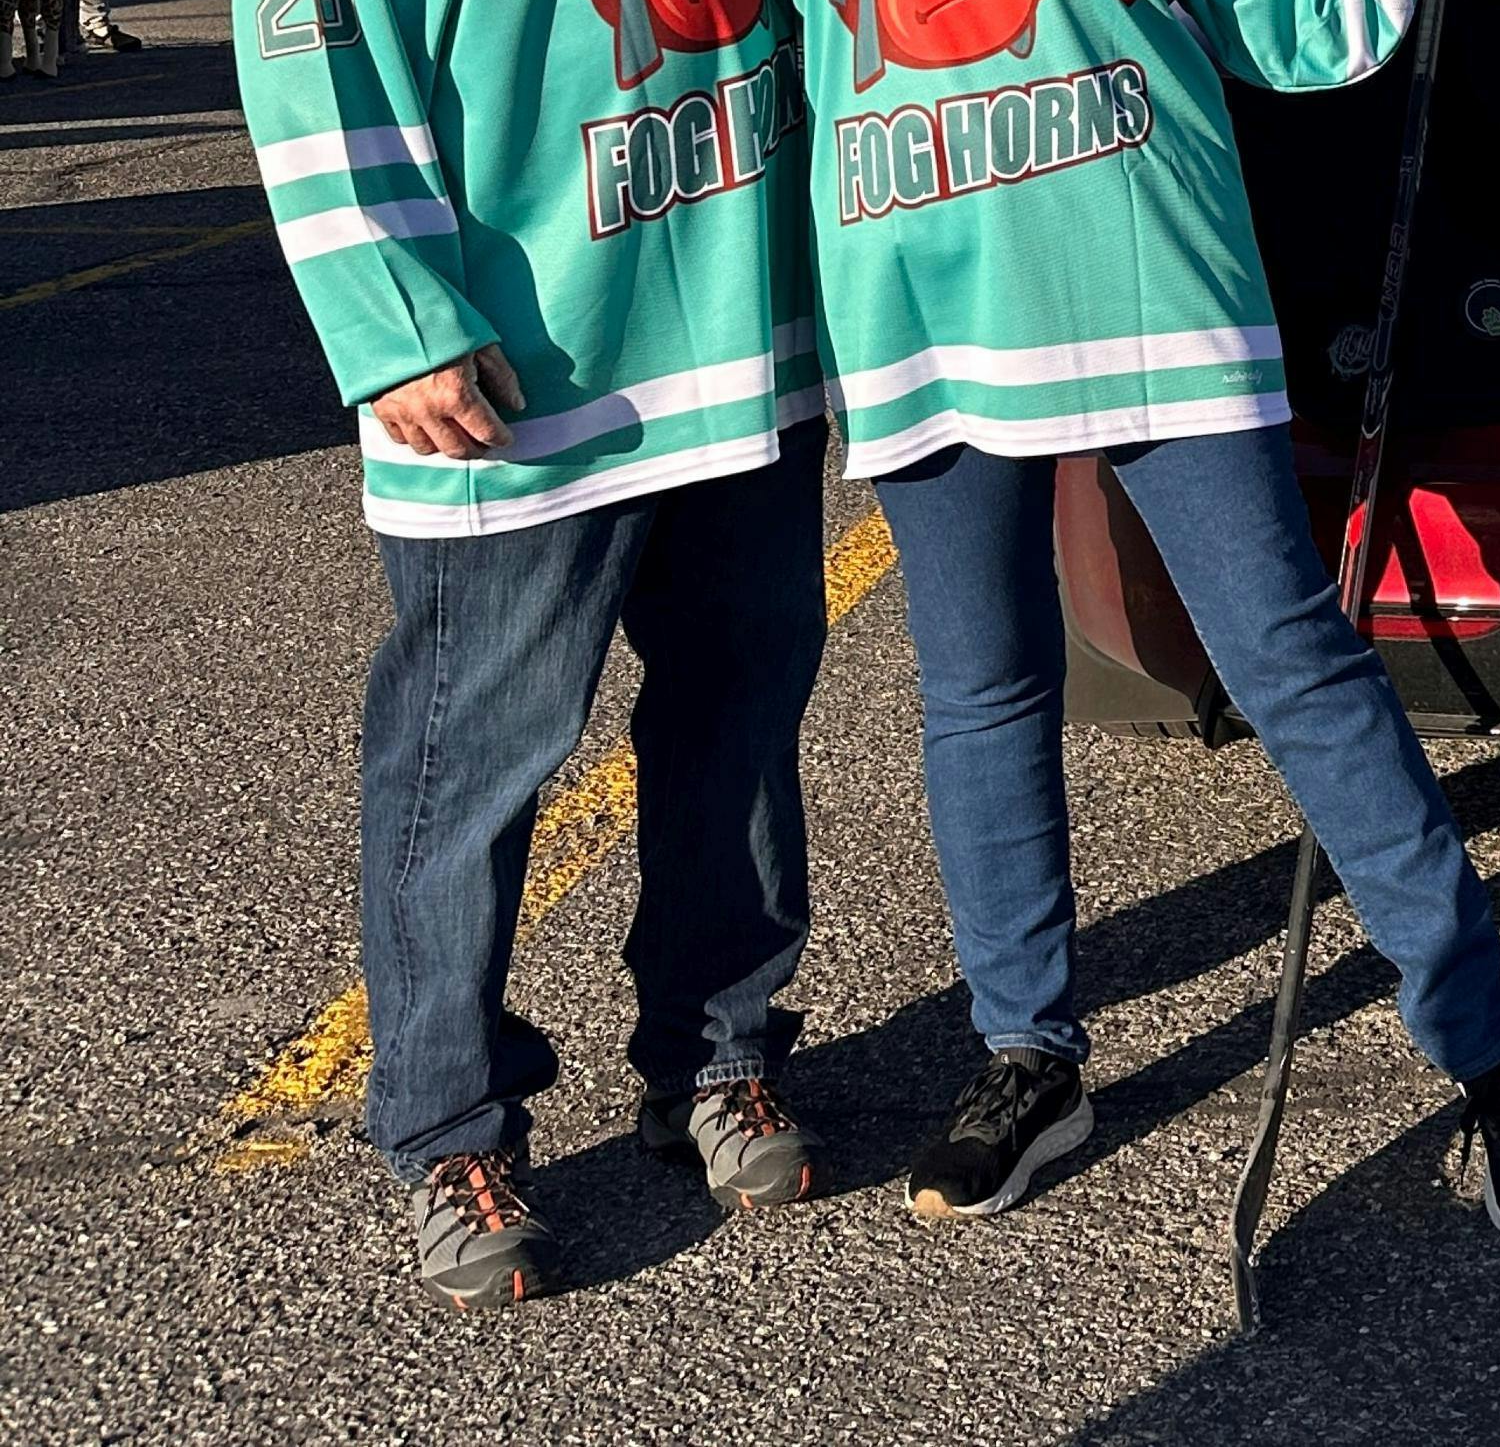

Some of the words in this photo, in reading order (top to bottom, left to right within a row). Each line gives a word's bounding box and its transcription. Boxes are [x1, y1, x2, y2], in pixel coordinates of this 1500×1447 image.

[583, 95, 724, 238] FOG
[836, 107, 938, 225] FOG
[938, 60, 1153, 196] HORNS
